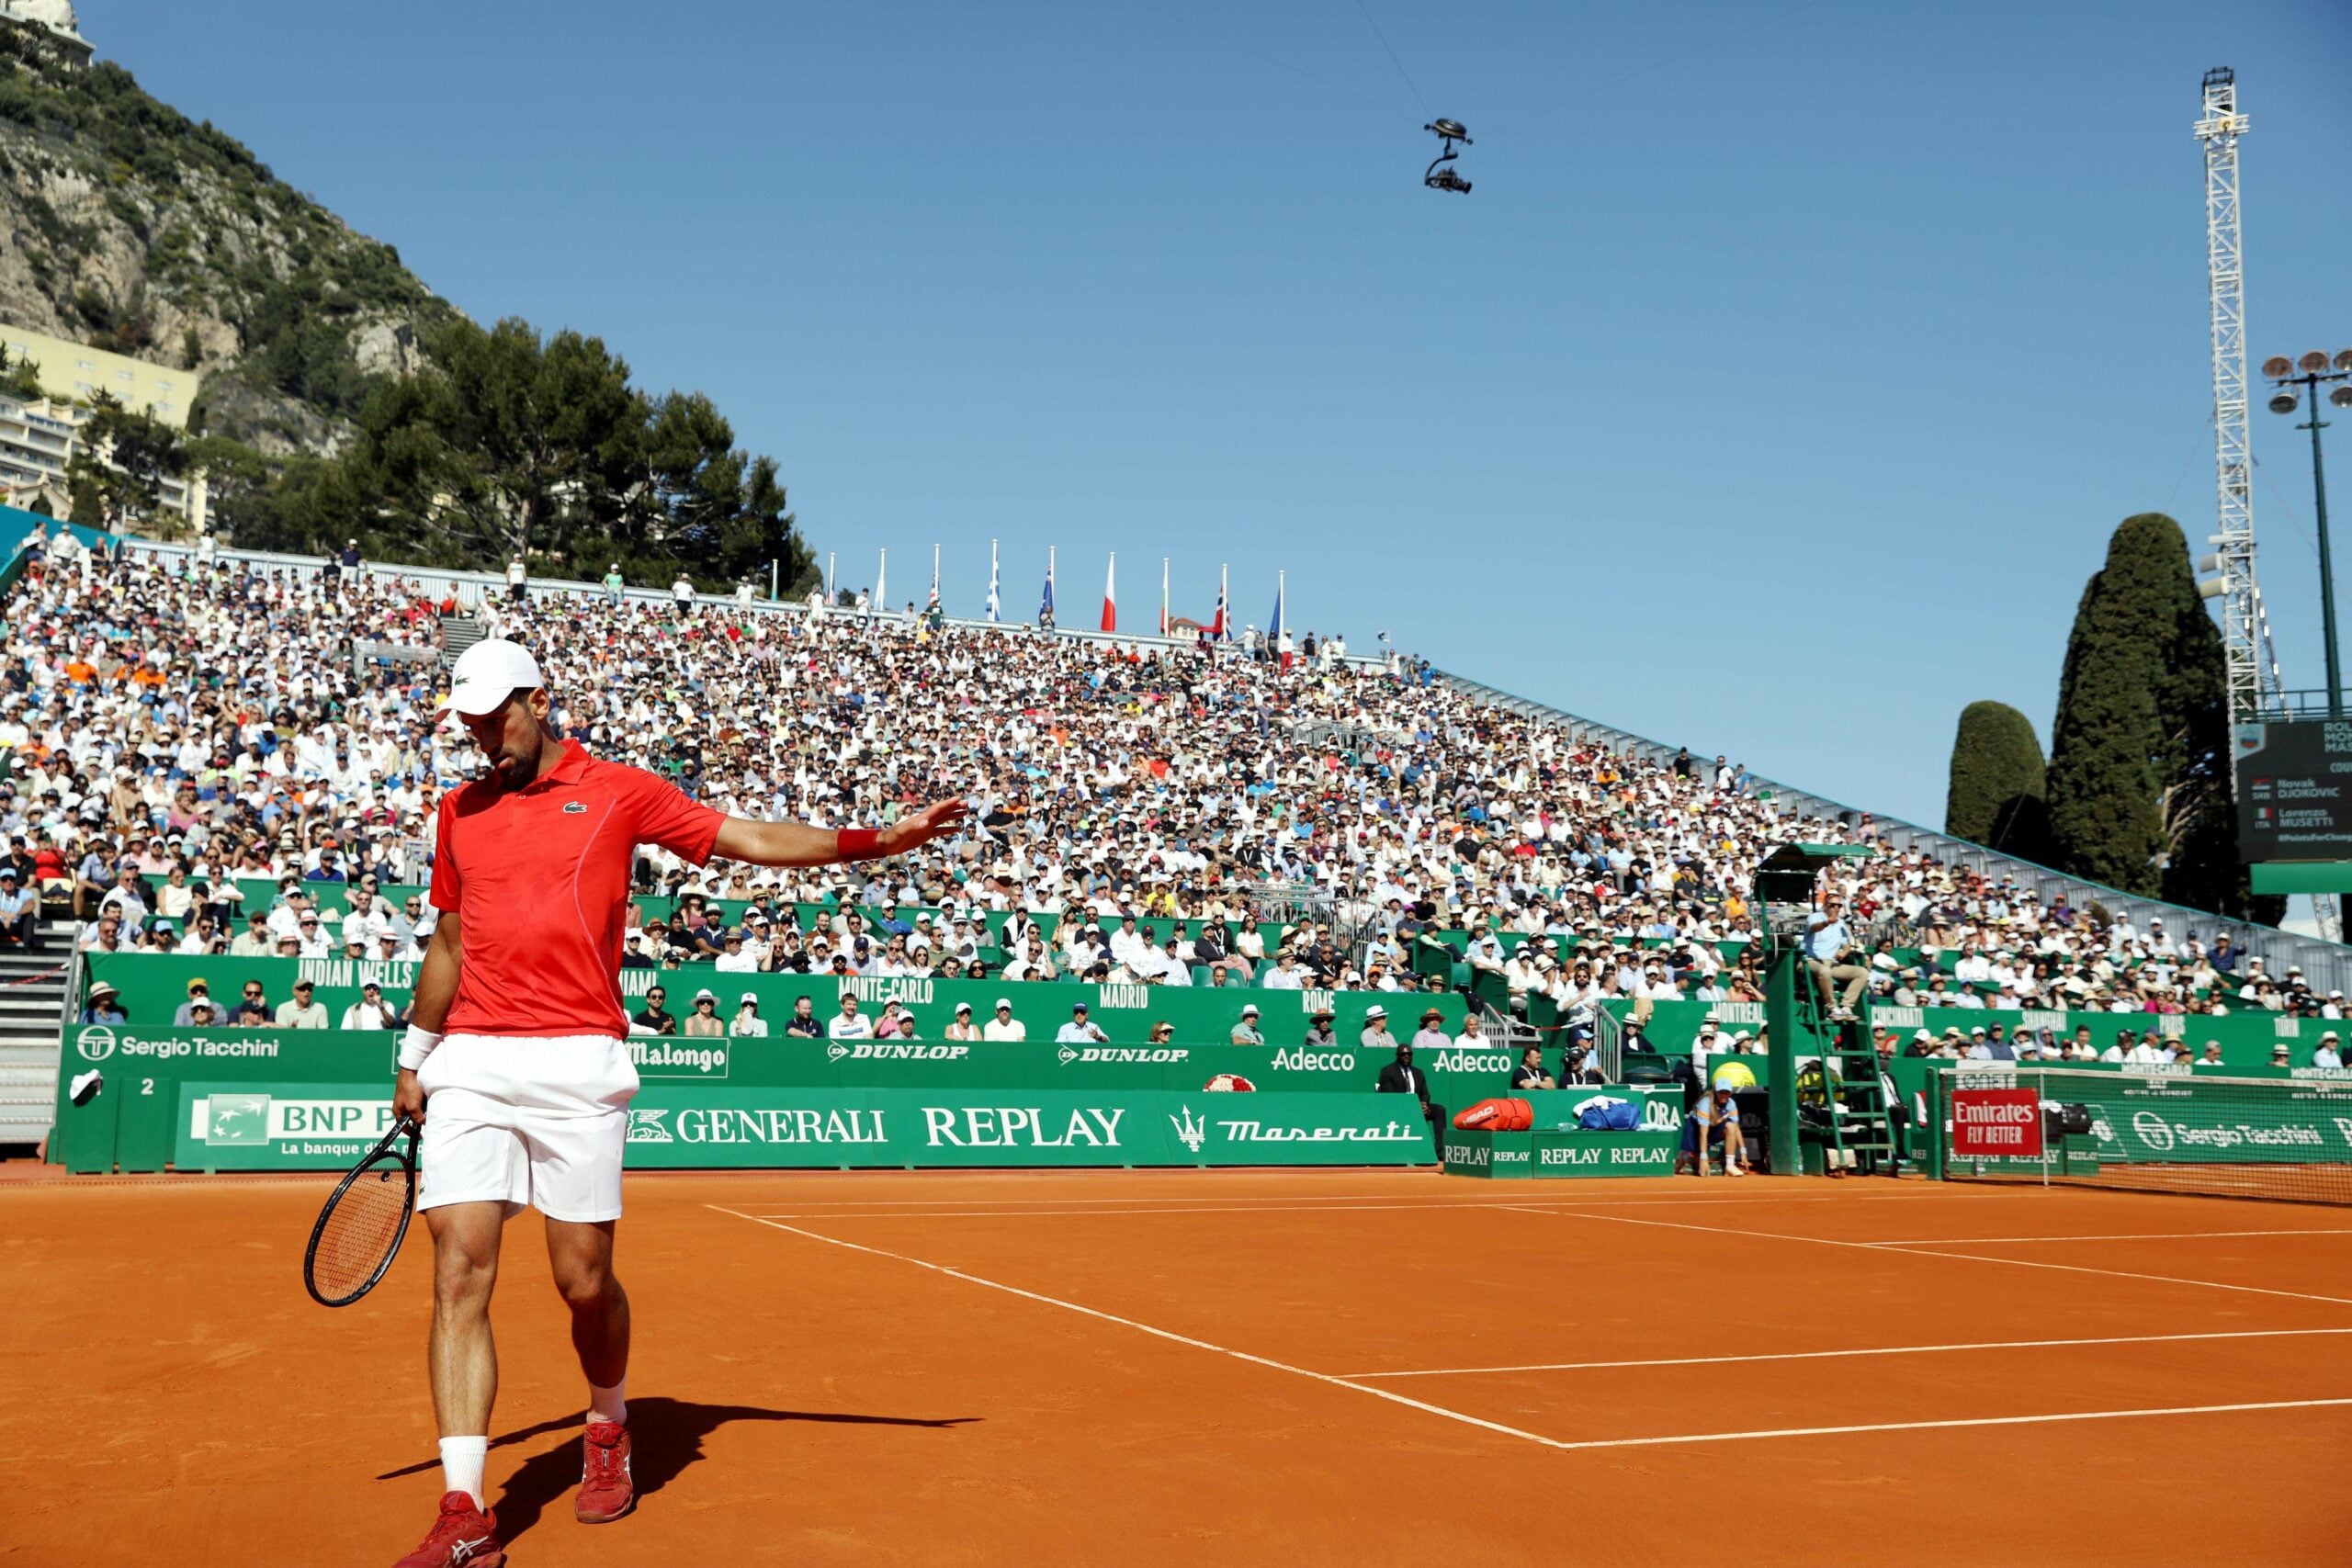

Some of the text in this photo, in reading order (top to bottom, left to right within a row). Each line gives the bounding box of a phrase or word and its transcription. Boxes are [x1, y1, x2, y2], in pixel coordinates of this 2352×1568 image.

[2277, 778, 2315, 788] Novak
[2278, 787, 2340, 798] DJOKOVIC
[2252, 792, 2271, 800] SRB
[2278, 809, 2327, 818] Lorenzo
[2278, 817, 2334, 827] MUSETTI
[299, 959, 413, 988] INDIAN WELLS
[838, 976, 933, 1004] MONTE-CARLO
[1100, 984, 1148, 1009] MADRID
[1303, 991, 1335, 1013] ROME
[1713, 1001, 1762, 1023] MONTREAL
[1871, 1006, 1924, 1027] CINCINNATI
[2021, 1010, 2067, 1032] SHANGHAI
[2159, 1014, 2186, 1035] PARIS
[121, 1036, 278, 1058] Sergio Tacchini
[625, 1042, 726, 1073] Malongo
[851, 1045, 969, 1060] DUNLOP
[1080, 1049, 1189, 1063] DUNLOP
[1271, 1047, 1355, 1071] Adecco
[1432, 1049, 1511, 1073] Adecco
[141, 1078, 154, 1095] 2
[283, 1107, 363, 1132] BNP
[1463, 1106, 1494, 1126] HEAD
[1954, 1100, 2035, 1122] Emirates
[676, 1109, 888, 1144] GENERALI
[921, 1107, 1125, 1146] REPLAY
[1216, 1121, 1423, 1141] Maserati
[1967, 1126, 2023, 1144] FLY BETTER
[2174, 1123, 2243, 1148] Sergio
[2235, 1124, 2324, 1145] Tacchini
[281, 1143, 299, 1154] La
[303, 1143, 358, 1156] banque
[1445, 1145, 1490, 1166] REPLAY
[1494, 1151, 1531, 1161] REPLAY
[1541, 1147, 1669, 1165] REPLAY REPLAY
